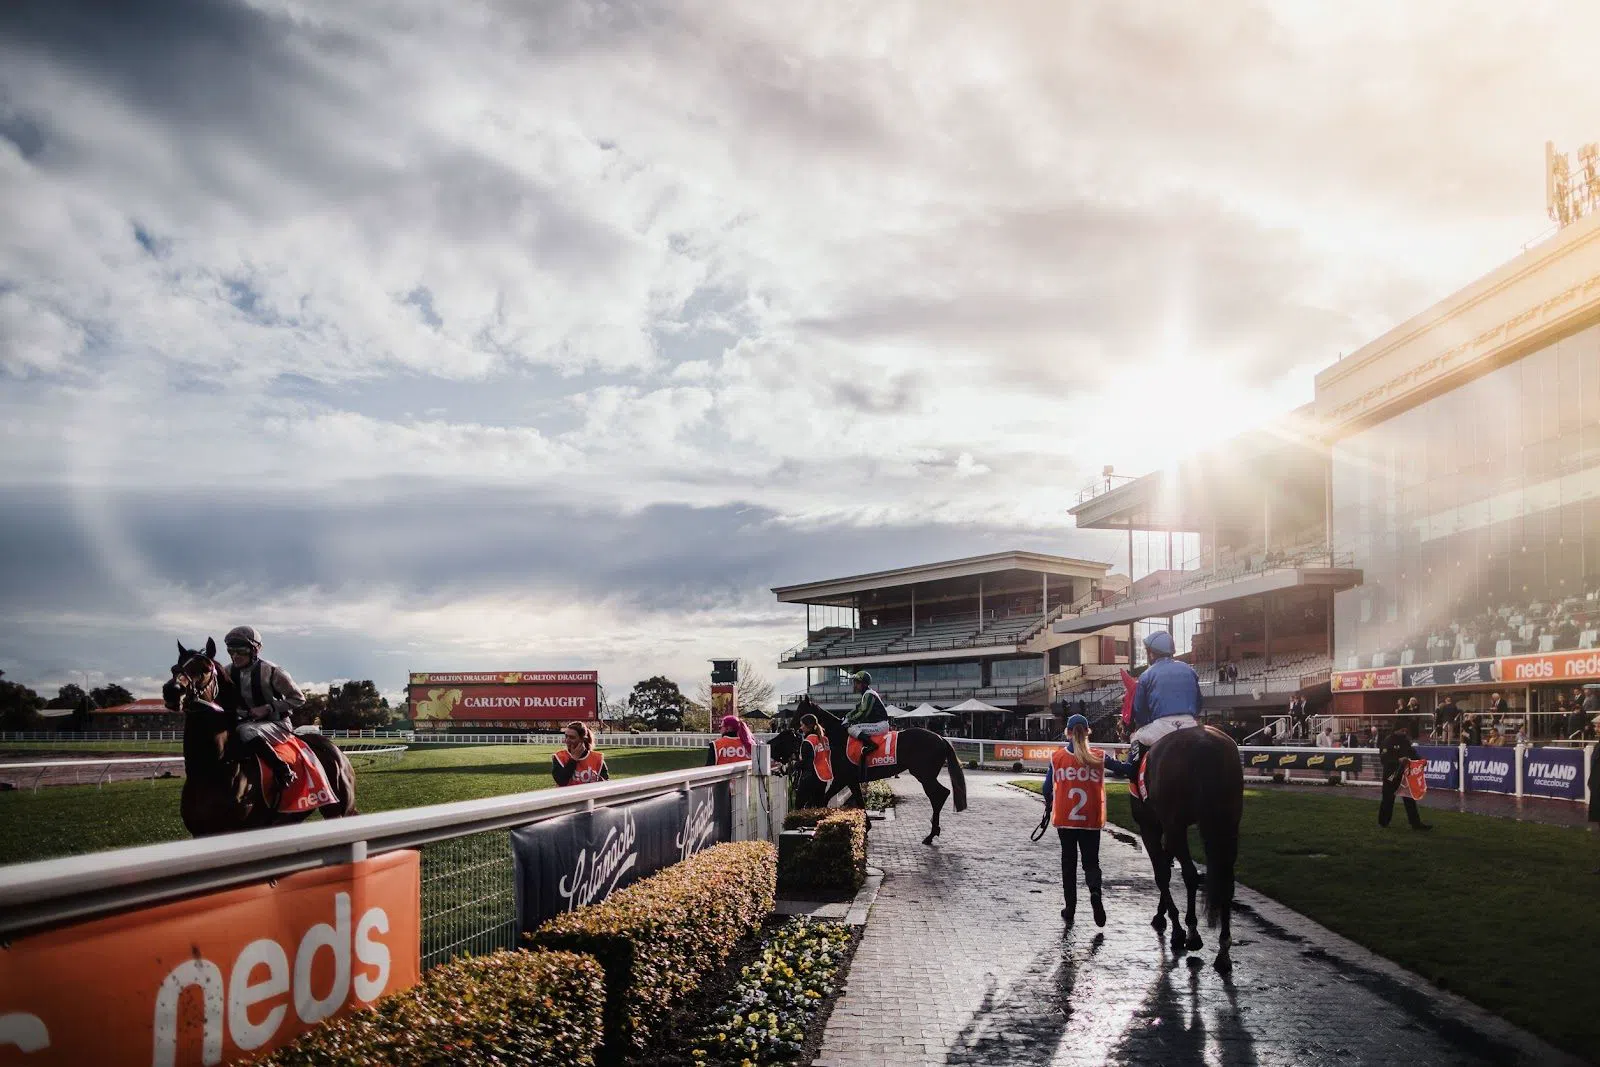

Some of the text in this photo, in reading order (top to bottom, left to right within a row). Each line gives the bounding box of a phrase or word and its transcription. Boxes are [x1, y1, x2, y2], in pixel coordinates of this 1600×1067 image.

[1516, 658, 1553, 678] neds
[430, 674, 462, 682] CARLTON
[523, 673, 556, 681] CARLTON
[464, 696, 586, 708] CARLTON DRAUGHT
[883, 733, 892, 755] 1
[1000, 746, 1024, 757] neds
[872, 755, 895, 765] neds
[1055, 765, 1101, 782] neds
[1468, 761, 1509, 776] HYLAND
[1528, 763, 1577, 781] HYLAND
[1472, 774, 1503, 784] racecolours
[1534, 778, 1570, 789] racecolours
[1068, 787, 1088, 821] 2
[152, 891, 391, 1067] neds
